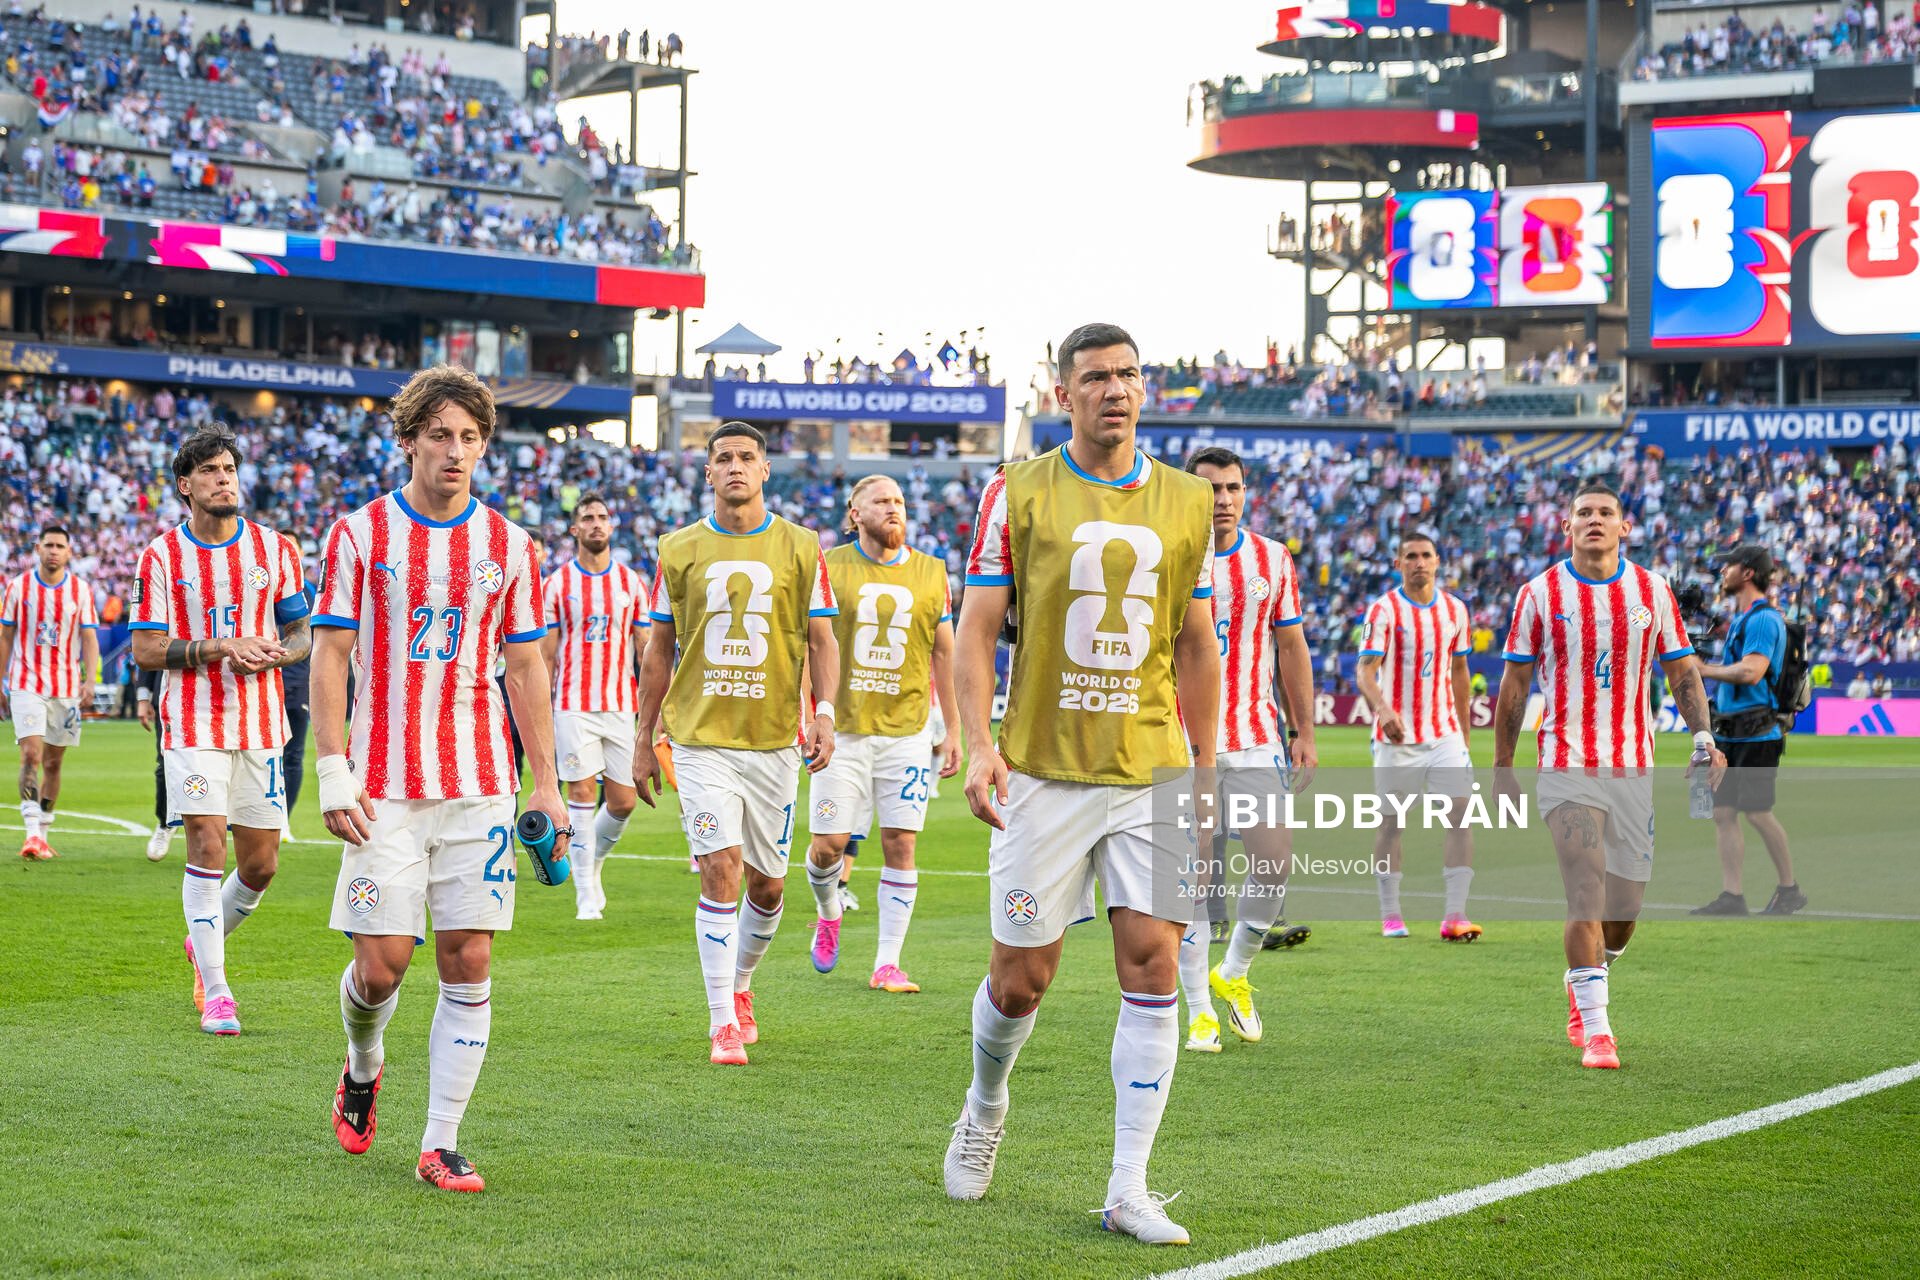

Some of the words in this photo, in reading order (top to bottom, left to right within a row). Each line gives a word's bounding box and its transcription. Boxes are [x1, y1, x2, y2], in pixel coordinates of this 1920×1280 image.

[168, 356, 355, 388] PHILADELPHIA
[735, 389, 783, 410] FIFA
[784, 390, 862, 411] WORLD
[865, 391, 908, 412] CUP
[910, 393, 987, 413] 2026
[1685, 414, 1749, 441] FIFA
[1753, 412, 1864, 440] WORLD
[208, 605, 238, 638] 15
[586, 614, 609, 642] 21
[36, 622, 59, 646] 24
[409, 606, 462, 662] 23
[721, 645, 751, 656] FIFA
[868, 650, 891, 661] FIFA
[1091, 640, 1132, 656] FIFA
[703, 669, 743, 680] WORLD
[745, 670, 766, 681] CUP
[851, 669, 882, 680] WORLD
[884, 671, 902, 682] CUP
[1421, 651, 1434, 678] 2
[1595, 650, 1612, 688] 4
[703, 682, 765, 699] 2026
[849, 679, 900, 696] 2026
[1061, 672, 1120, 689] WORLD
[1059, 689, 1140, 715] 2026
[900, 765, 930, 802] 25
